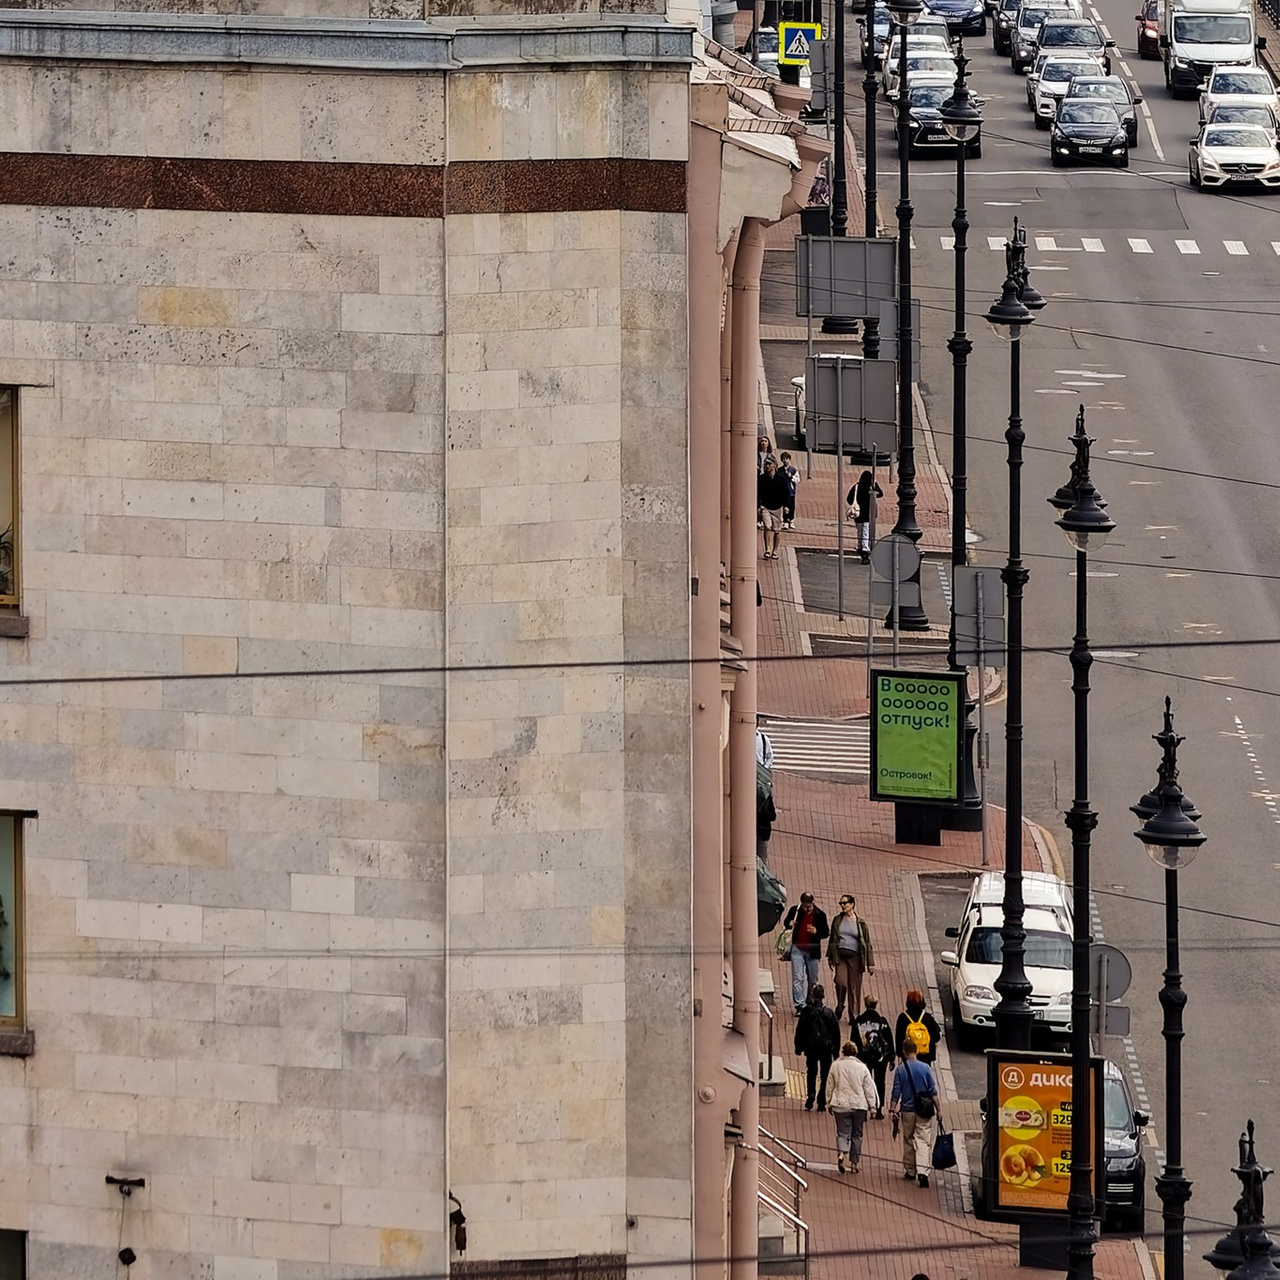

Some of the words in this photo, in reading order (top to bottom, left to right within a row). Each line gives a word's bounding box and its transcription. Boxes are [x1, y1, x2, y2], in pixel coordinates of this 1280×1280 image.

[881, 678, 892, 692] В
[881, 713, 950, 731] отпуск!
[880, 767, 932, 781] Островок!
